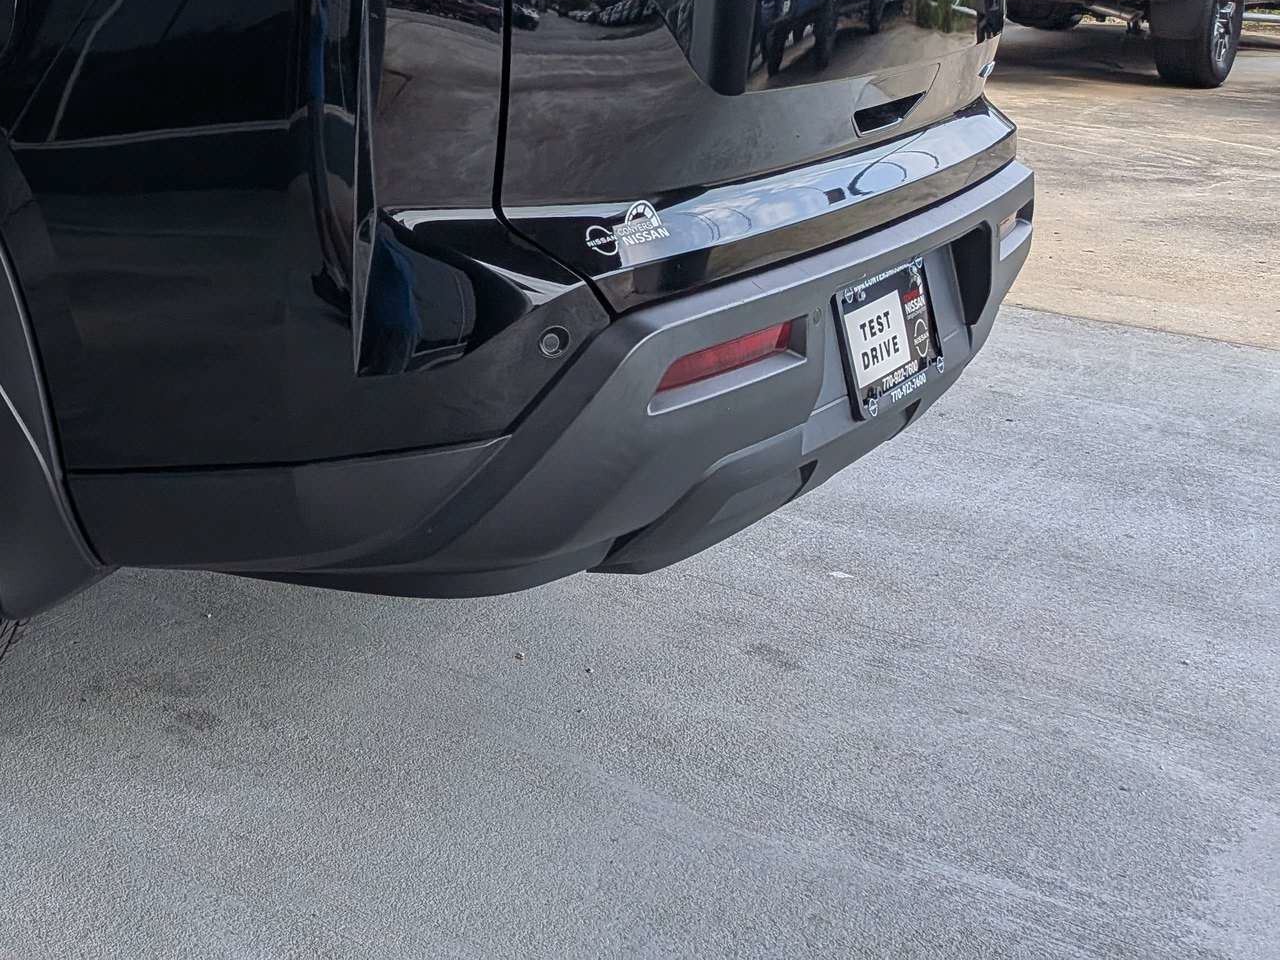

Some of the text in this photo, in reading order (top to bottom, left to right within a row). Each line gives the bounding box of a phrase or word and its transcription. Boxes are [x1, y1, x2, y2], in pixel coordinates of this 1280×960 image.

[586, 234, 618, 248] NISSAN
[621, 227, 670, 246] NISSAN
[904, 294, 926, 315] NISSAN
[859, 310, 892, 342] TEST
[861, 335, 901, 371] DRIVE
[882, 359, 919, 391] 770-922-7600
[890, 372, 927, 403] 770-922-7600
